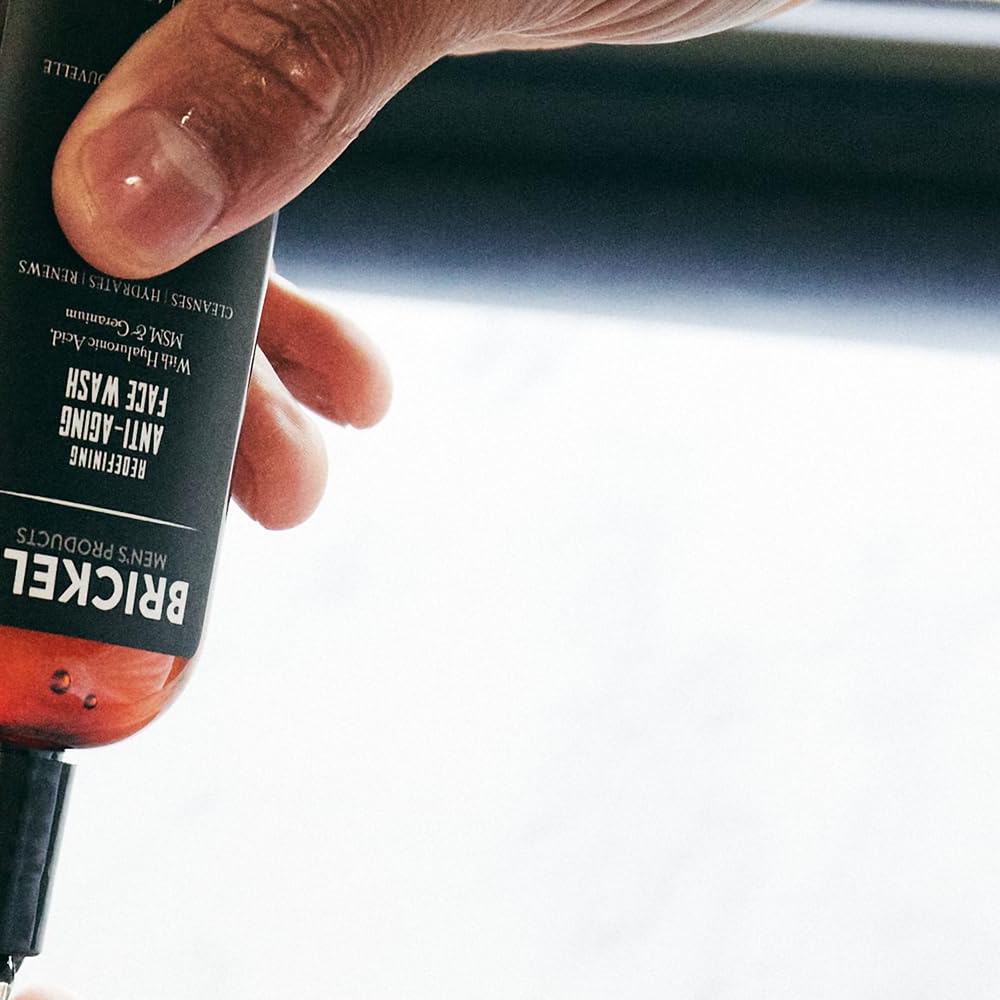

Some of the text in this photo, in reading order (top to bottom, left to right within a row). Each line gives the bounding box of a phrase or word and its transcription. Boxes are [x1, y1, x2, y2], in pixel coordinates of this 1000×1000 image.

[18, 259, 234, 320] CLEANSES HYDRATES RENEWS
[65, 308, 130, 337] Geranium
[131, 324, 147, 341] &
[87, 338, 158, 368] Hyaluronic
[160, 354, 191, 376] With
[65, 367, 169, 418] FACE WASH
[58, 405, 164, 456] ANTI-AGING
[69, 445, 147, 480] REDEFINING
[16, 527, 168, 570] MEN'S PRODUCTS
